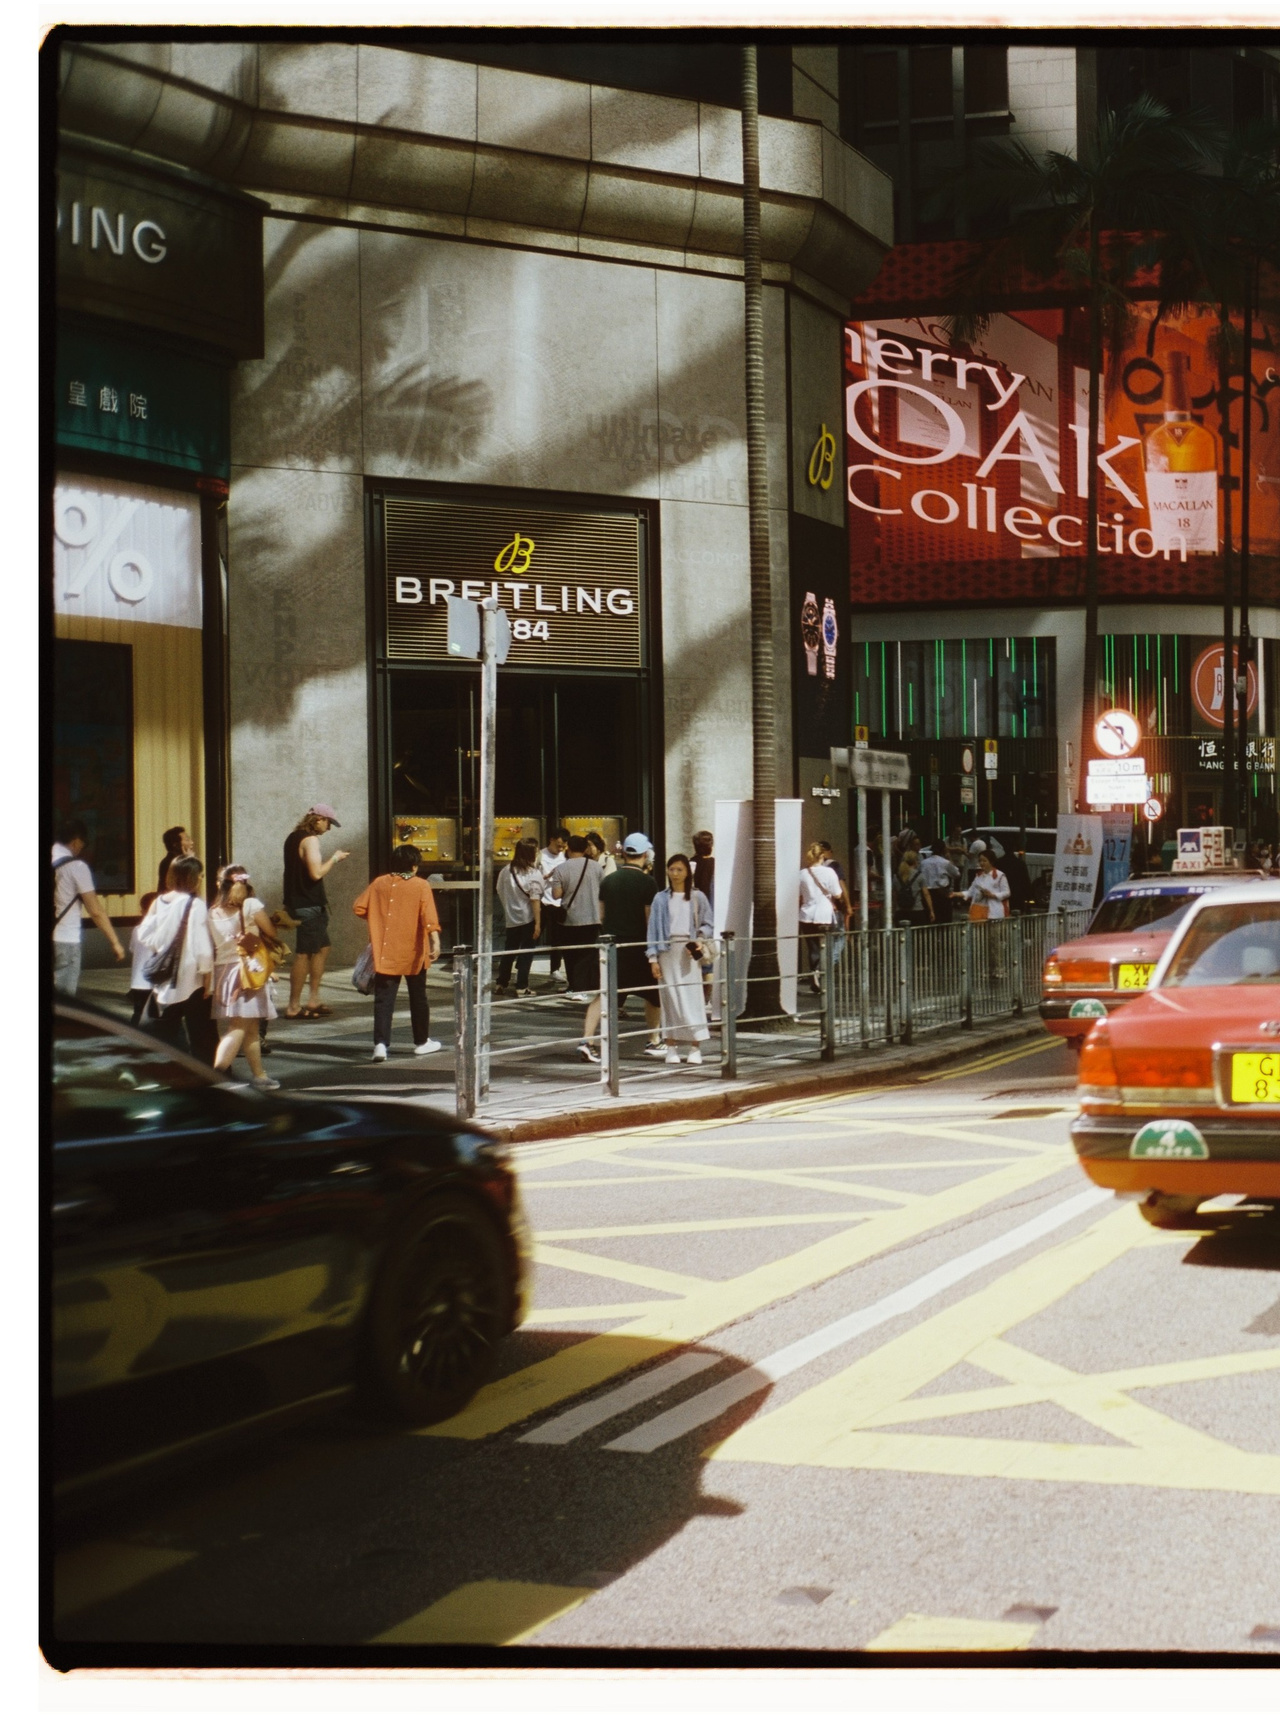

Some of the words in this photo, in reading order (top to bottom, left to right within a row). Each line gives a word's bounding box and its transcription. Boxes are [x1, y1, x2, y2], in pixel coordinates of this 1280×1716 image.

[57, 200, 168, 265] ING
[1152, 500, 1214, 512] MACALLAN
[1177, 517, 1191, 529] 18
[395, 576, 635, 616] BREITLING
[508, 619, 550, 641] 84
[1198, 740, 1275, 758] 恒銀行
[1254, 761, 1276, 771] BANK
[812, 787, 841, 797] BREITLING
[1174, 861, 1201, 869] TAXI
[1061, 899, 1083, 907] CENTRAL
[1123, 977, 1150, 988] 644
